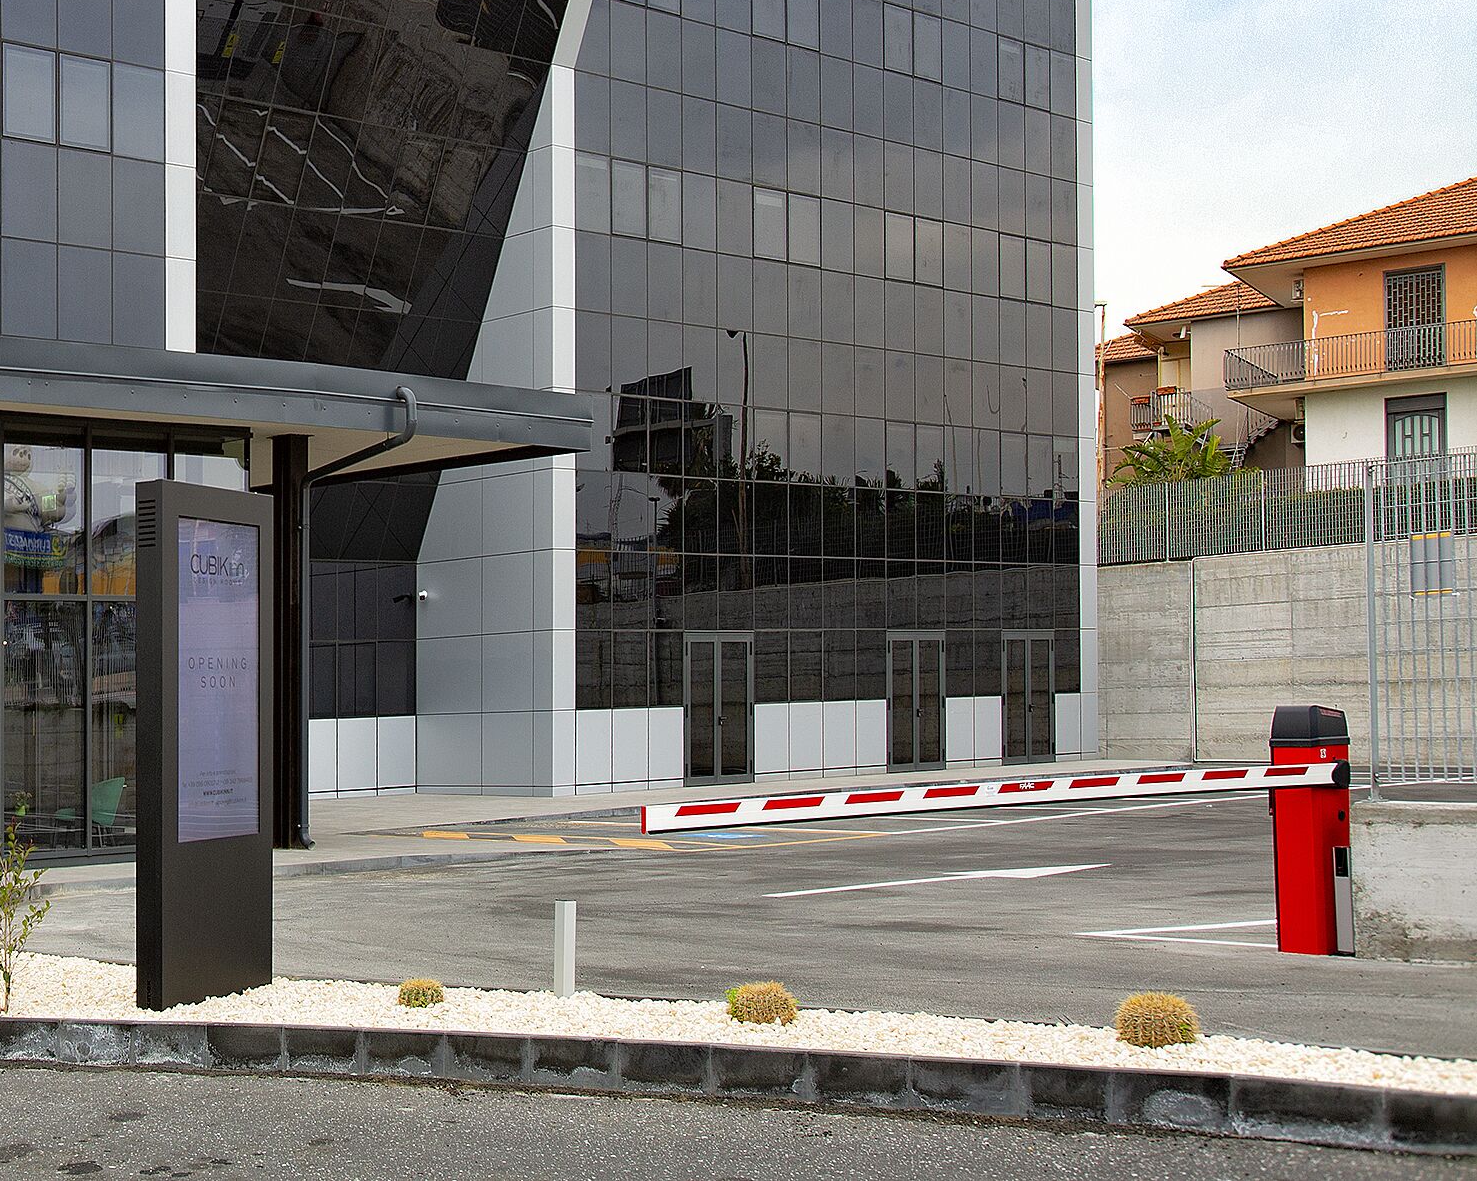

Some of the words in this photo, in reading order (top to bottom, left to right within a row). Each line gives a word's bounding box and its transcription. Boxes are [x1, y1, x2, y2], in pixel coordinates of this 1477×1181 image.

[190, 553, 229, 576] CUBIK
[188, 656, 248, 670] OPENING
[200, 675, 236, 689] SOON
[1019, 782, 1035, 790] FAAC
